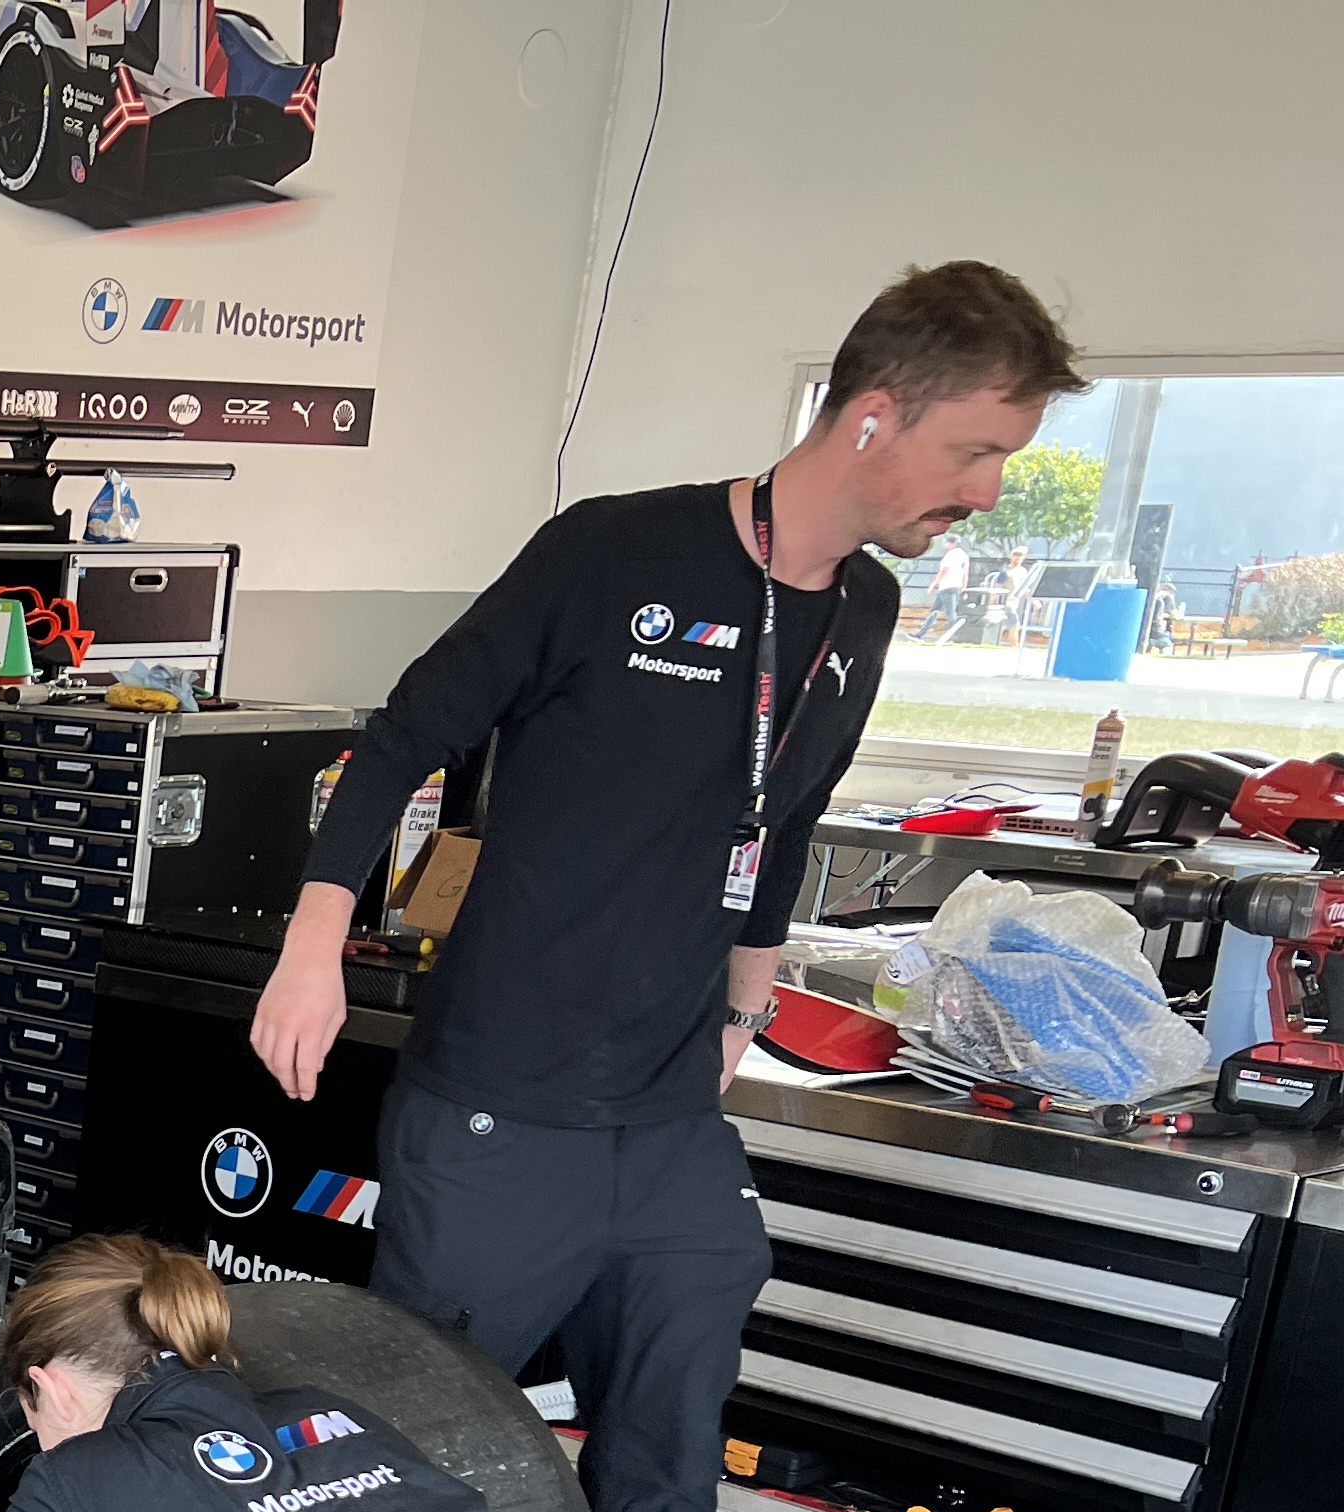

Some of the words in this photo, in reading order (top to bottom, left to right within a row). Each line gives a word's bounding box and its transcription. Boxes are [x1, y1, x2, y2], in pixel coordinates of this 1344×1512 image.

[215, 300, 366, 348] Motorsport
[79, 392, 148, 420] iQOO
[628, 652, 723, 683] Motorsport
[751, 672, 772, 788] WeatherTech
[407, 820, 435, 831] Clean
[409, 806, 438, 819] Brake
[214, 1133, 266, 1163] BMW
[199, 1432, 249, 1454] BMW
